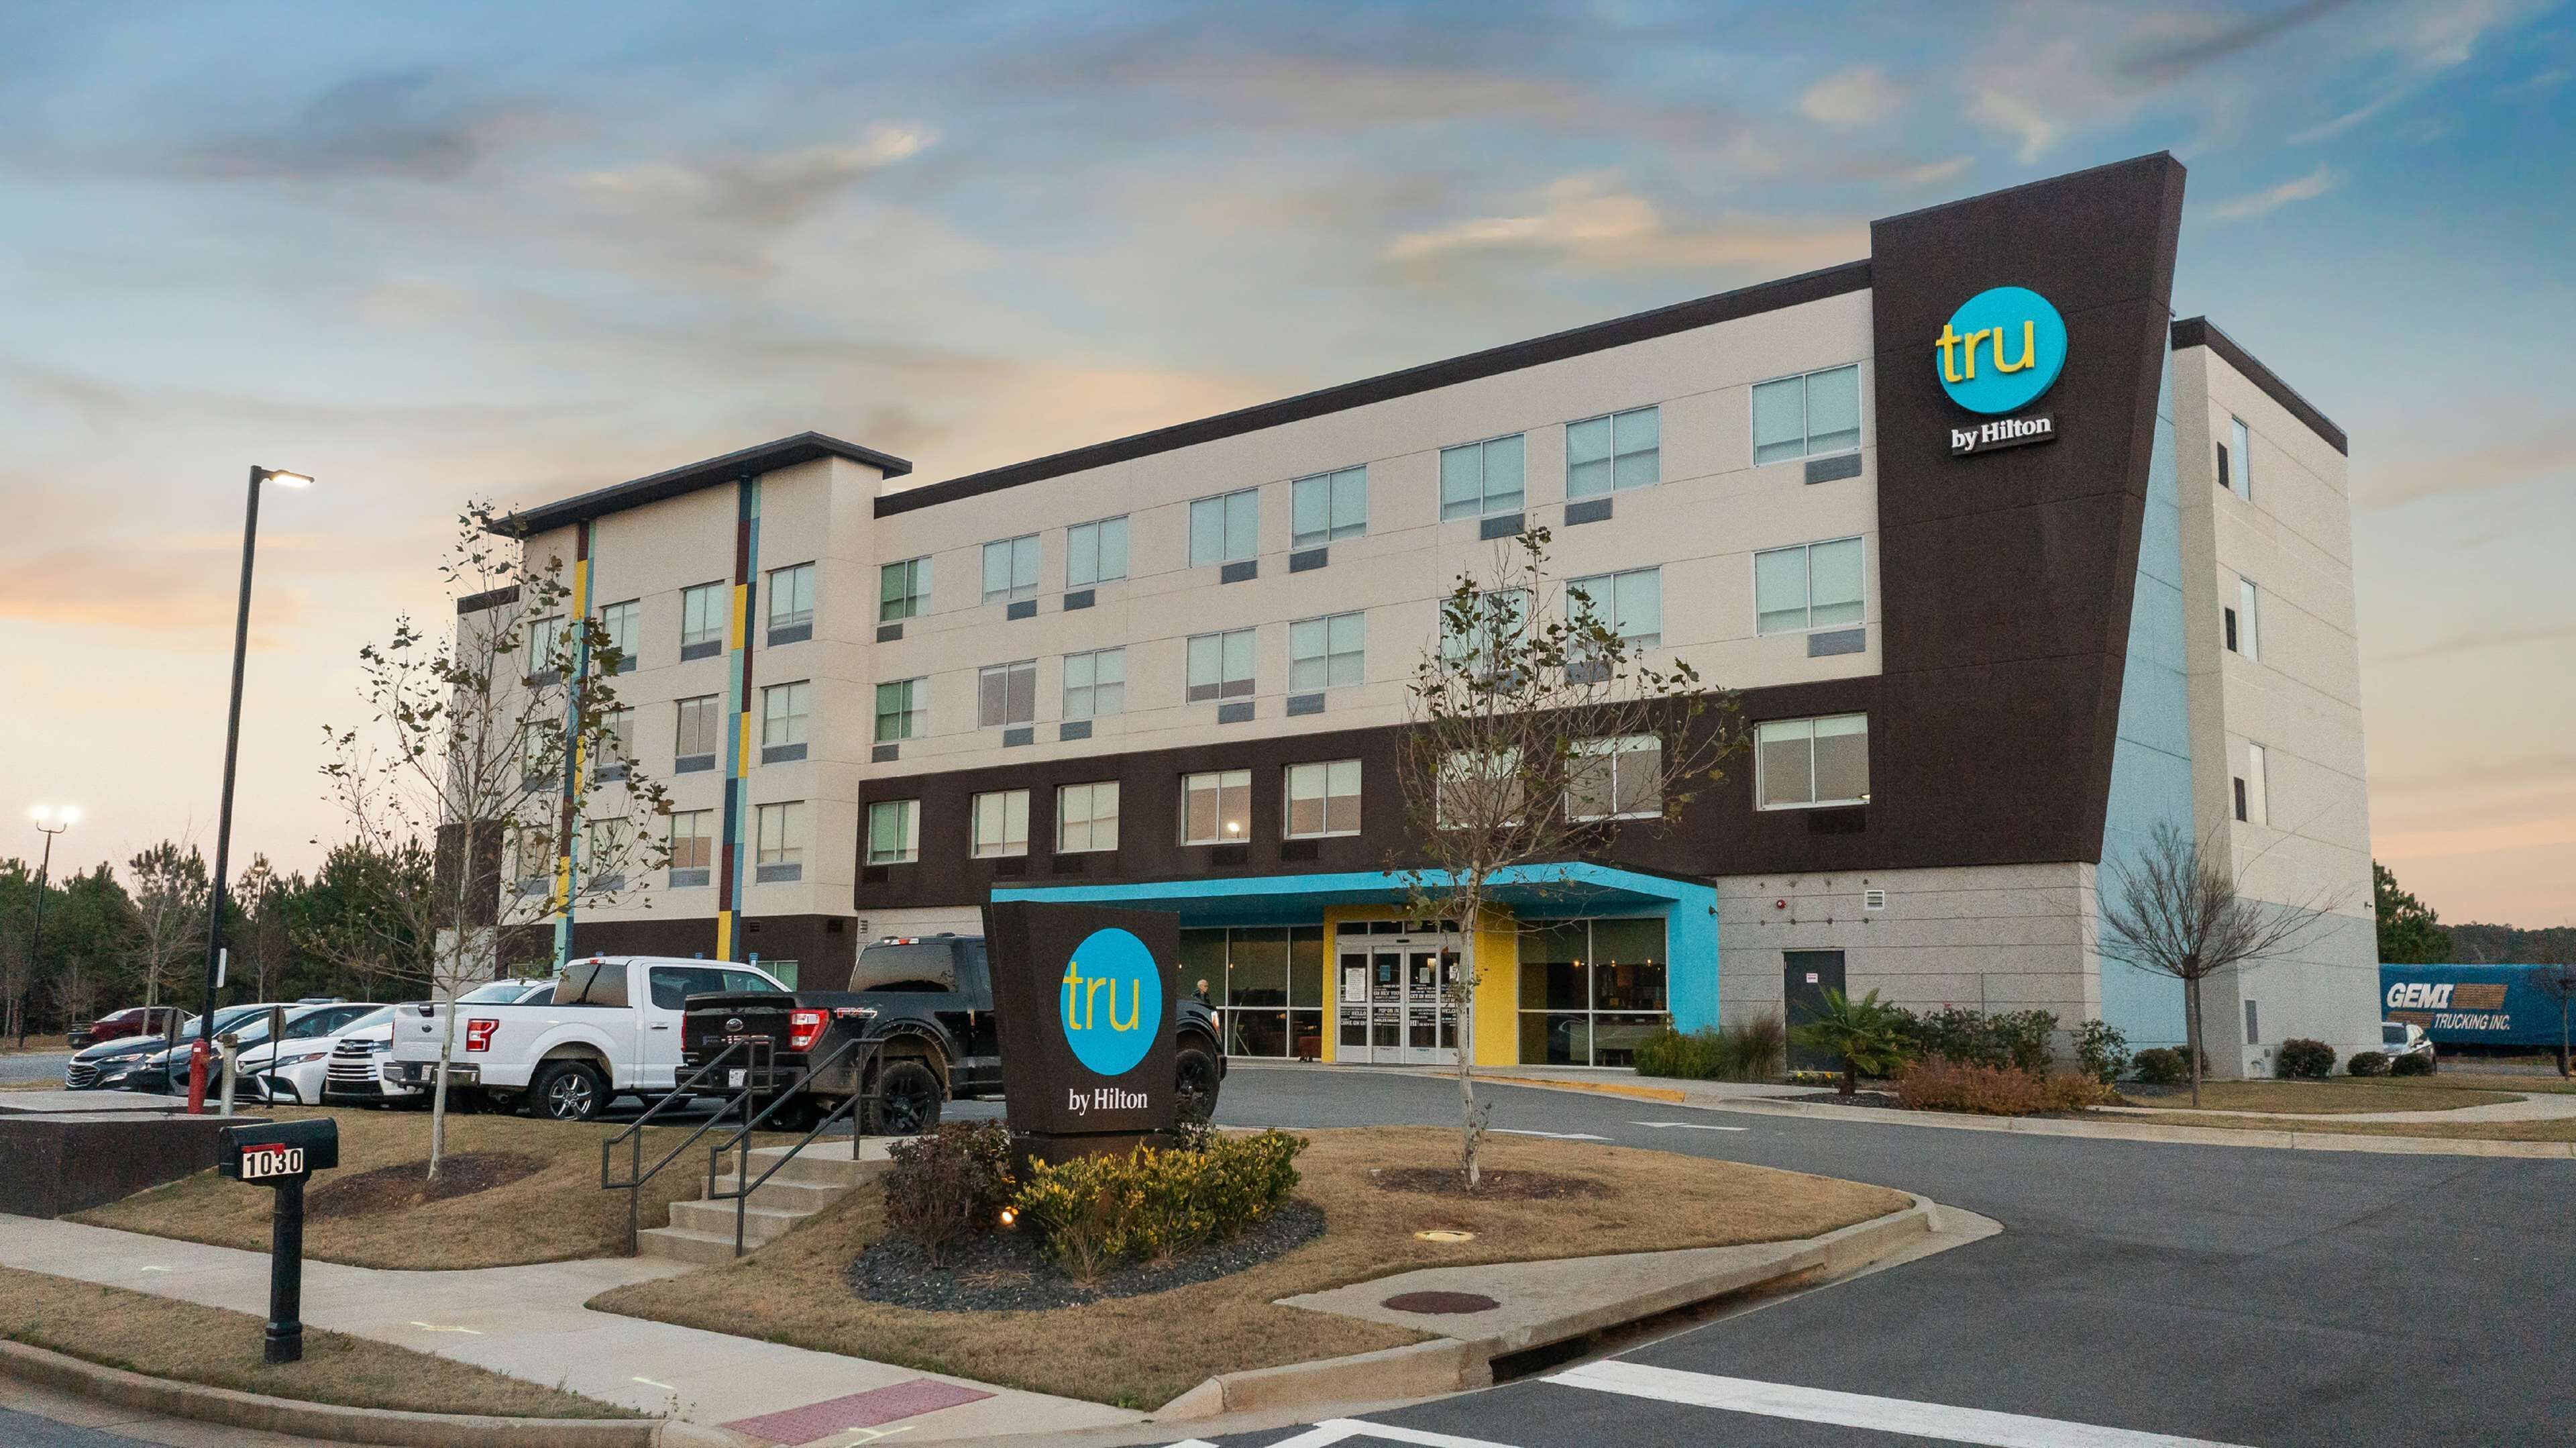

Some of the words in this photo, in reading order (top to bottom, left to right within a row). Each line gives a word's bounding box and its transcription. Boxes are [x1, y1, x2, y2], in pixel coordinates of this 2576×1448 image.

[1935, 320, 2035, 382] tru
[1951, 429, 1979, 451] by
[1981, 417, 2052, 443] Hilton
[1062, 961, 1140, 1032] tru
[2386, 982, 2455, 1009] GEMI
[2434, 1013, 2487, 1029] TRUCKING
[2488, 1014, 2510, 1030] INC.
[1069, 1088, 1090, 1116] by
[1093, 1088, 1148, 1110] Hilton
[246, 1149, 301, 1176] 1030
